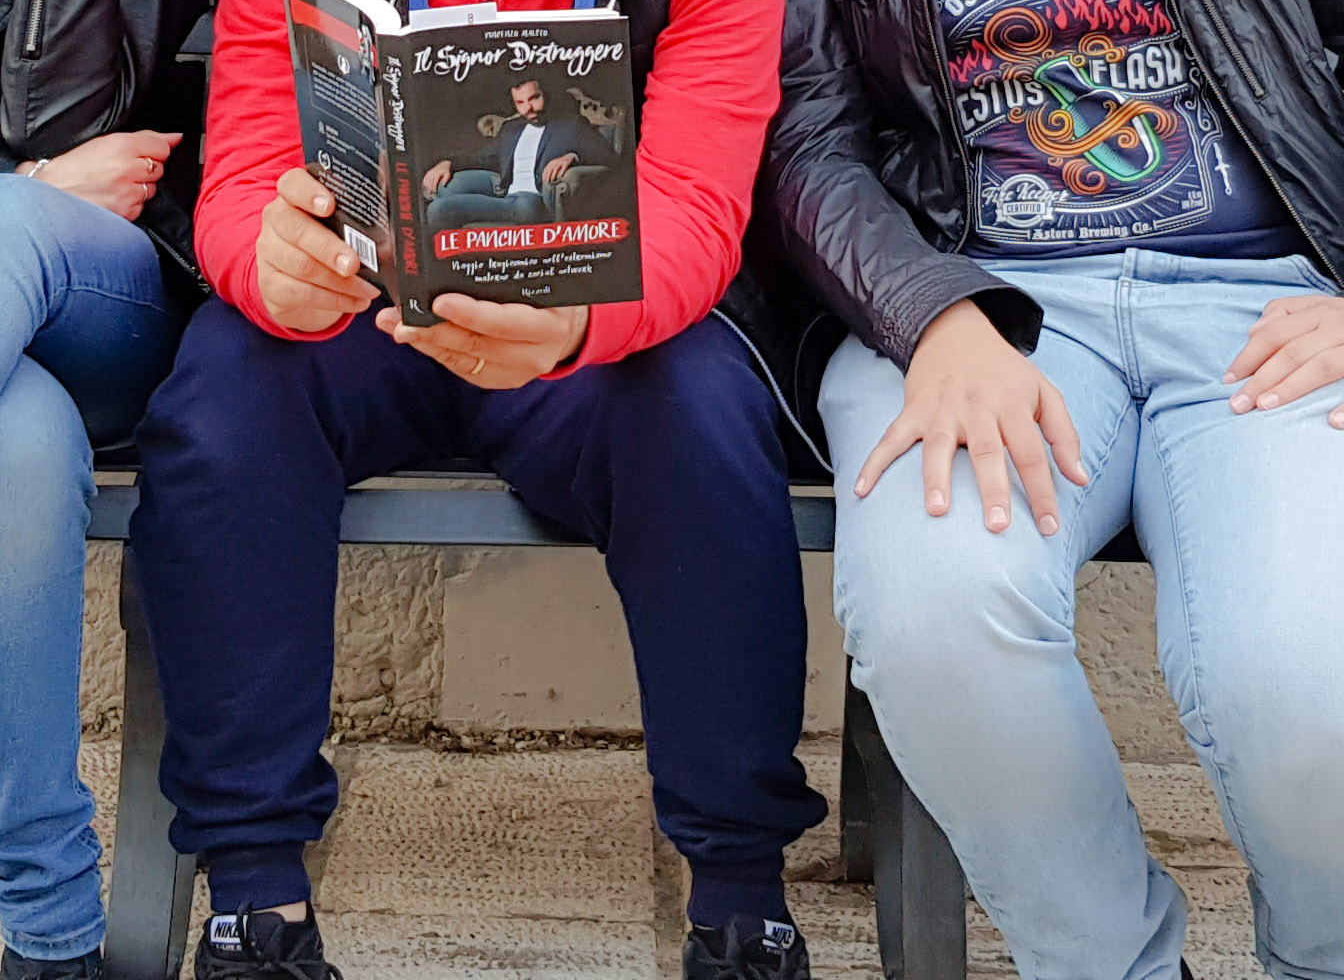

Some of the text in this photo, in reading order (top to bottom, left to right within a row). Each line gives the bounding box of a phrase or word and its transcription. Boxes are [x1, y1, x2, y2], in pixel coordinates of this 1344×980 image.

[413, 46, 433, 75] Il
[433, 44, 507, 83] Signor
[506, 40, 625, 77] Distruggere
[440, 220, 622, 252] LE PANCINE D'AMORE
[1031, 228, 1075, 241] Astora
